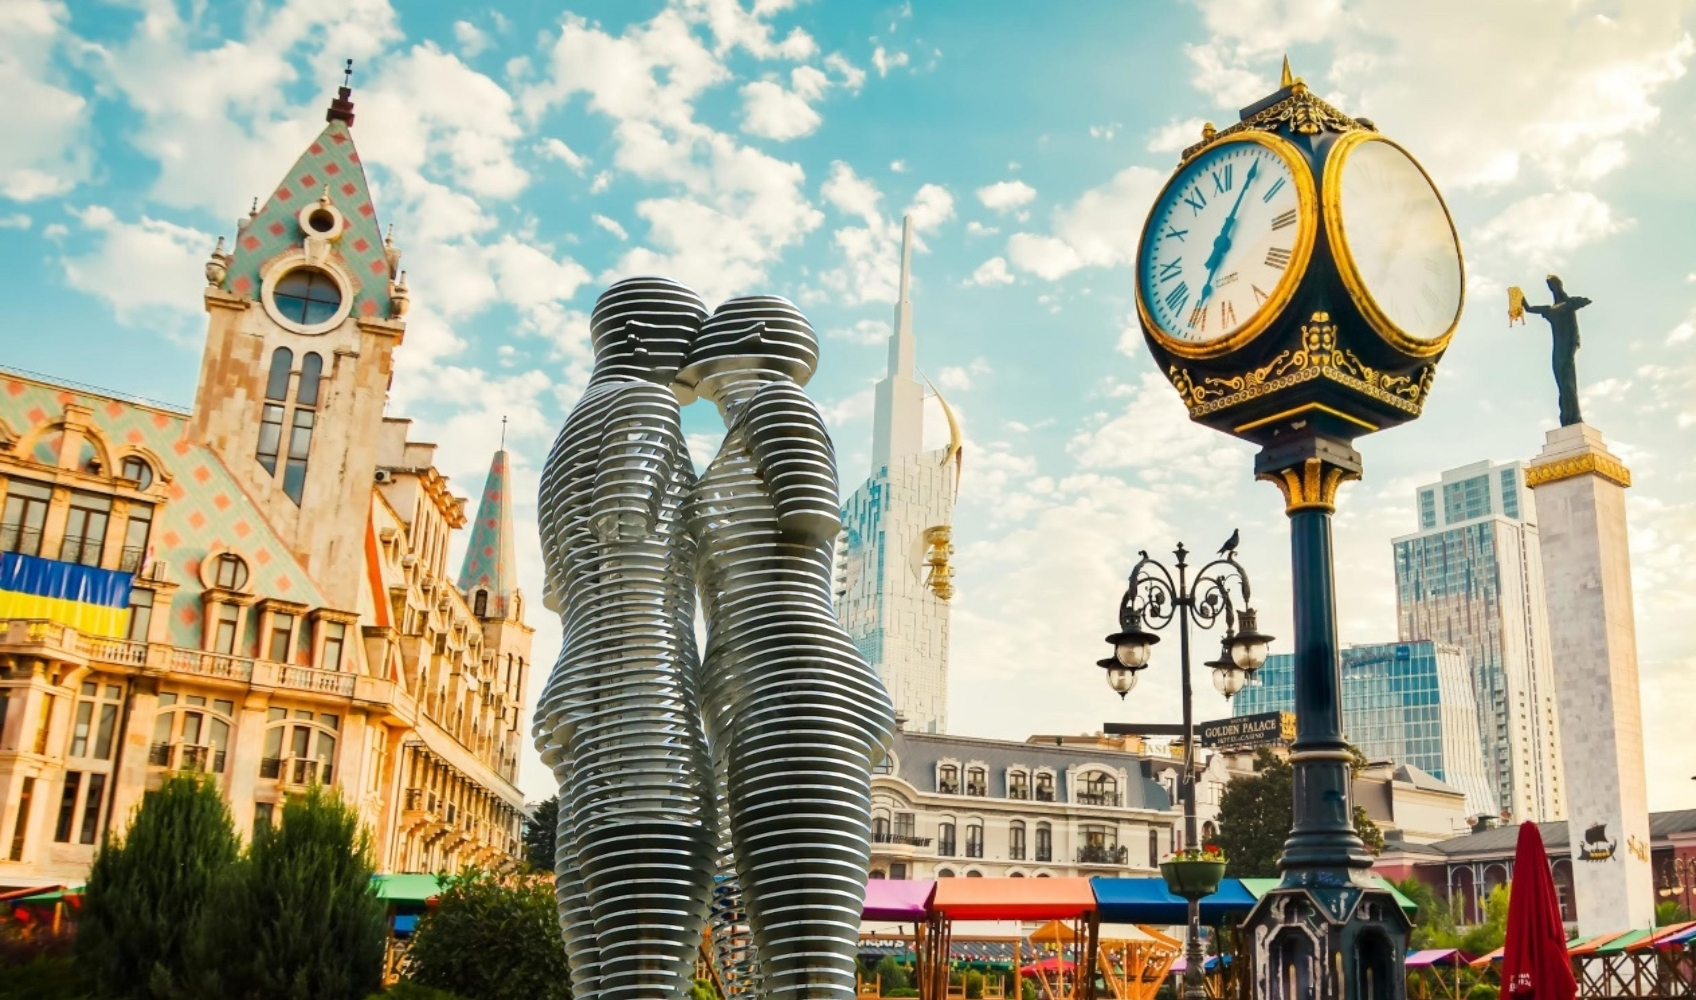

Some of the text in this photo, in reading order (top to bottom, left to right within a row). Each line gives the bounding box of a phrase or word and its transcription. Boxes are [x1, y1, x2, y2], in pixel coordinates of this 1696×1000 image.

[1213, 163, 1232, 198] XII
[1263, 176, 1286, 203] II
[1184, 186, 1207, 218] XI
[1271, 208, 1297, 231] III
[1165, 225, 1189, 242] X
[1160, 256, 1182, 283] IX
[1264, 247, 1292, 270] IIII
[1165, 281, 1190, 318] VIII
[1221, 300, 1237, 330] VI
[1205, 724, 1240, 738] GOLDEN
[1242, 719, 1277, 733] PALACE
[1217, 735, 1237, 744] HOTEL
[1240, 732, 1264, 741] CASINO
